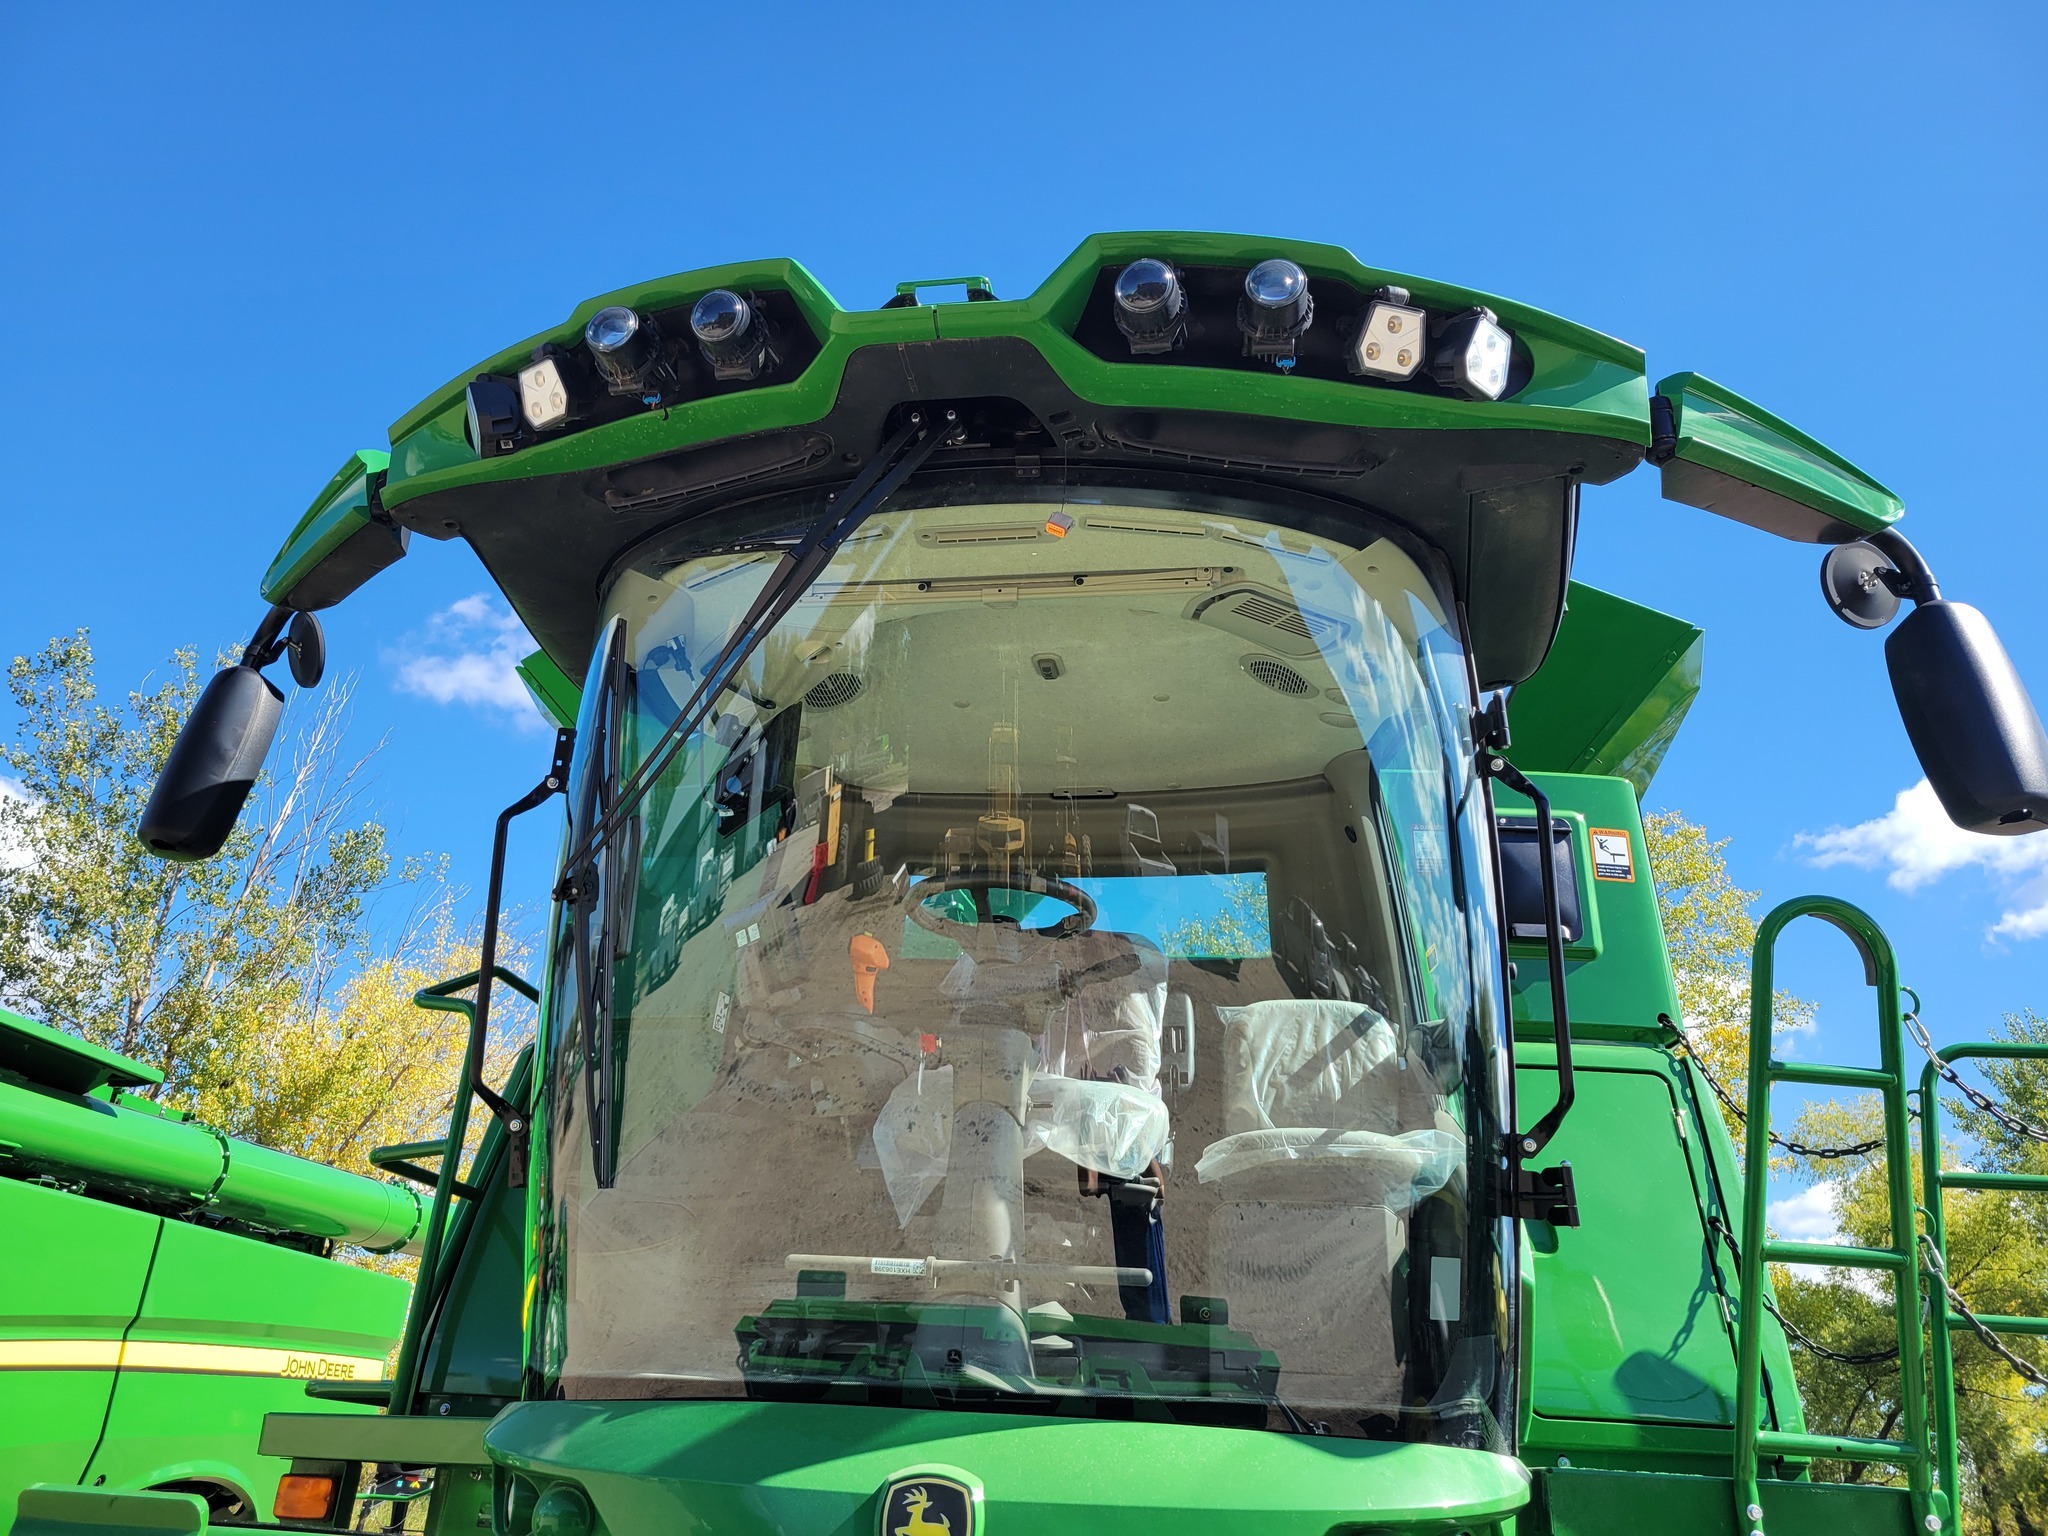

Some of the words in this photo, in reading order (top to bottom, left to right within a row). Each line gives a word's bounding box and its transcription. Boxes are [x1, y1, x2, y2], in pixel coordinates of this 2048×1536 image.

[874, 1266, 911, 1274] HXE106398
[282, 1355, 316, 1375] JOHN
[318, 1359, 355, 1379] DEERE
